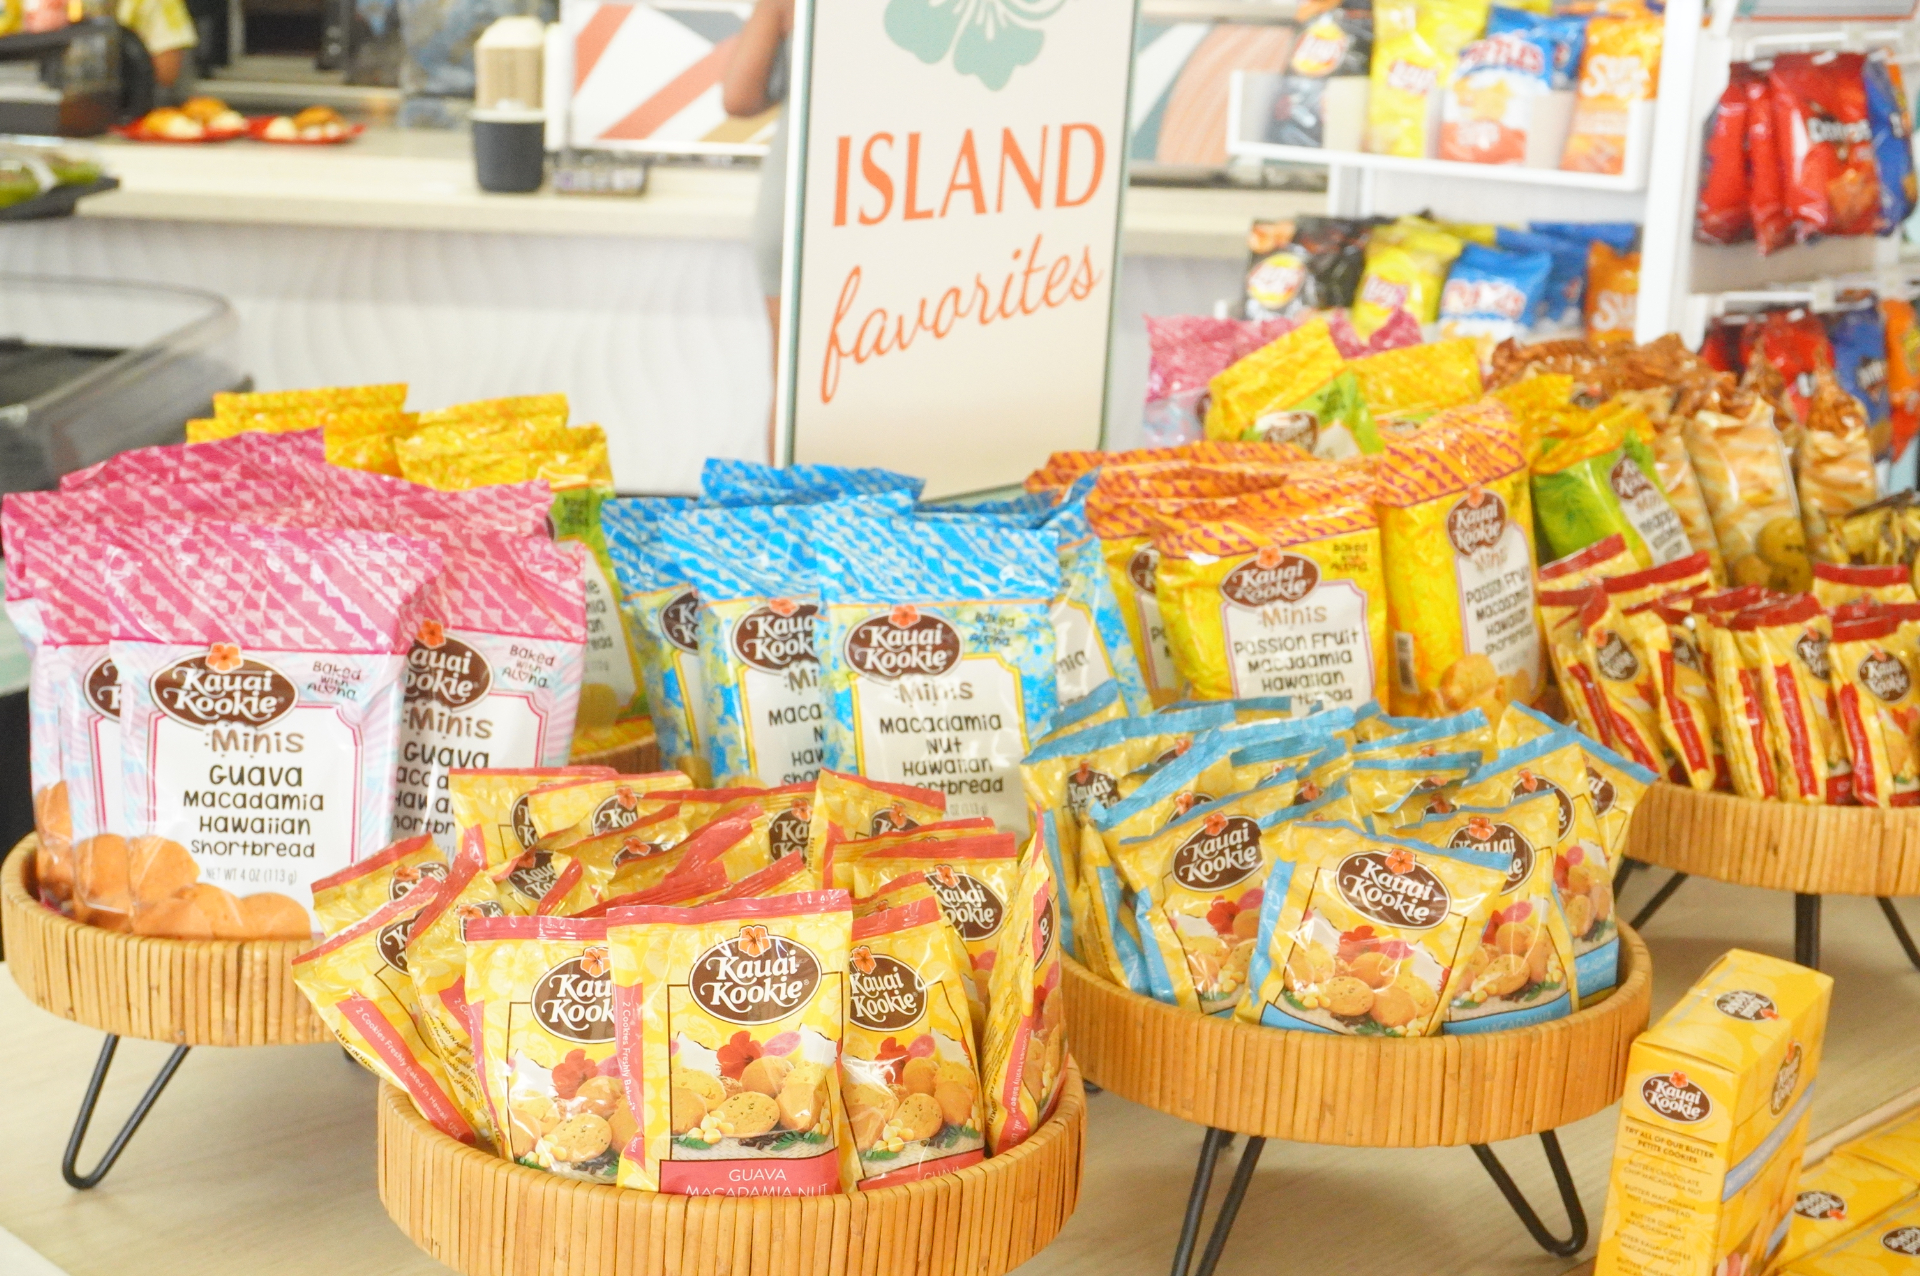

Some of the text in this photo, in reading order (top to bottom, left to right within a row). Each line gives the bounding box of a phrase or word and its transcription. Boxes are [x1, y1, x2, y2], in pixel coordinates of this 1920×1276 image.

[833, 123, 1106, 227] ISLAND
[820, 232, 1104, 405] favorites
[1231, 560, 1304, 588] Kauai
[1262, 606, 1328, 627] Minis
[743, 632, 814, 665] Kook
[859, 624, 944, 652] Kauai
[1234, 630, 1359, 656] Passion Fruit
[405, 648, 472, 674] auai
[509, 644, 556, 667] Baked
[854, 645, 948, 677] Kookie
[1248, 650, 1353, 673] Macadamia
[171, 665, 273, 700] Kauai
[312, 660, 361, 681] Baked
[1261, 670, 1345, 691] Hawaiian
[405, 668, 474, 703] ookie
[163, 688, 279, 721] Kookie
[408, 706, 494, 740] Minis
[880, 713, 1002, 734] Macadamia
[210, 728, 305, 754] Minis
[403, 741, 490, 768] Guava
[926, 737, 962, 754] Nut
[209, 764, 303, 788] Guava
[183, 790, 325, 812] Macadamia
[199, 815, 312, 836] Hawaiian
[191, 838, 316, 859] Shortbread
[1186, 822, 1251, 862] Kauai
[206, 867, 222, 882] NET
[224, 868, 239, 882] WT
[240, 868, 246, 882] 4
[248, 869, 261, 882] OZ
[1178, 845, 1258, 883] Kookie
[1354, 857, 1435, 901] Kauai
[1343, 873, 1431, 923] Kookie
[943, 902, 995, 929] ookie
[706, 950, 798, 985] Kauai
[850, 966, 905, 998] Kauai
[548, 974, 613, 1004] Kau
[699, 975, 803, 1013] Kookie
[541, 994, 615, 1031] Kook
[850, 988, 918, 1022] Kookie
[355, 1007, 364, 1015] 2
[361, 1013, 386, 1042] Cookies
[384, 1040, 406, 1067] Freshly
[622, 1009, 631, 1044] Cookies
[622, 1048, 633, 1077] Freshly
[1644, 1089, 1702, 1120] Kookie
[1650, 1078, 1702, 1105] Kauai
[1625, 1125, 1715, 1159] TRY ALL OF OUR BUTTER
[1637, 1139, 1698, 1164] PETITE COOKIES
[728, 1168, 787, 1182] GUAVA
